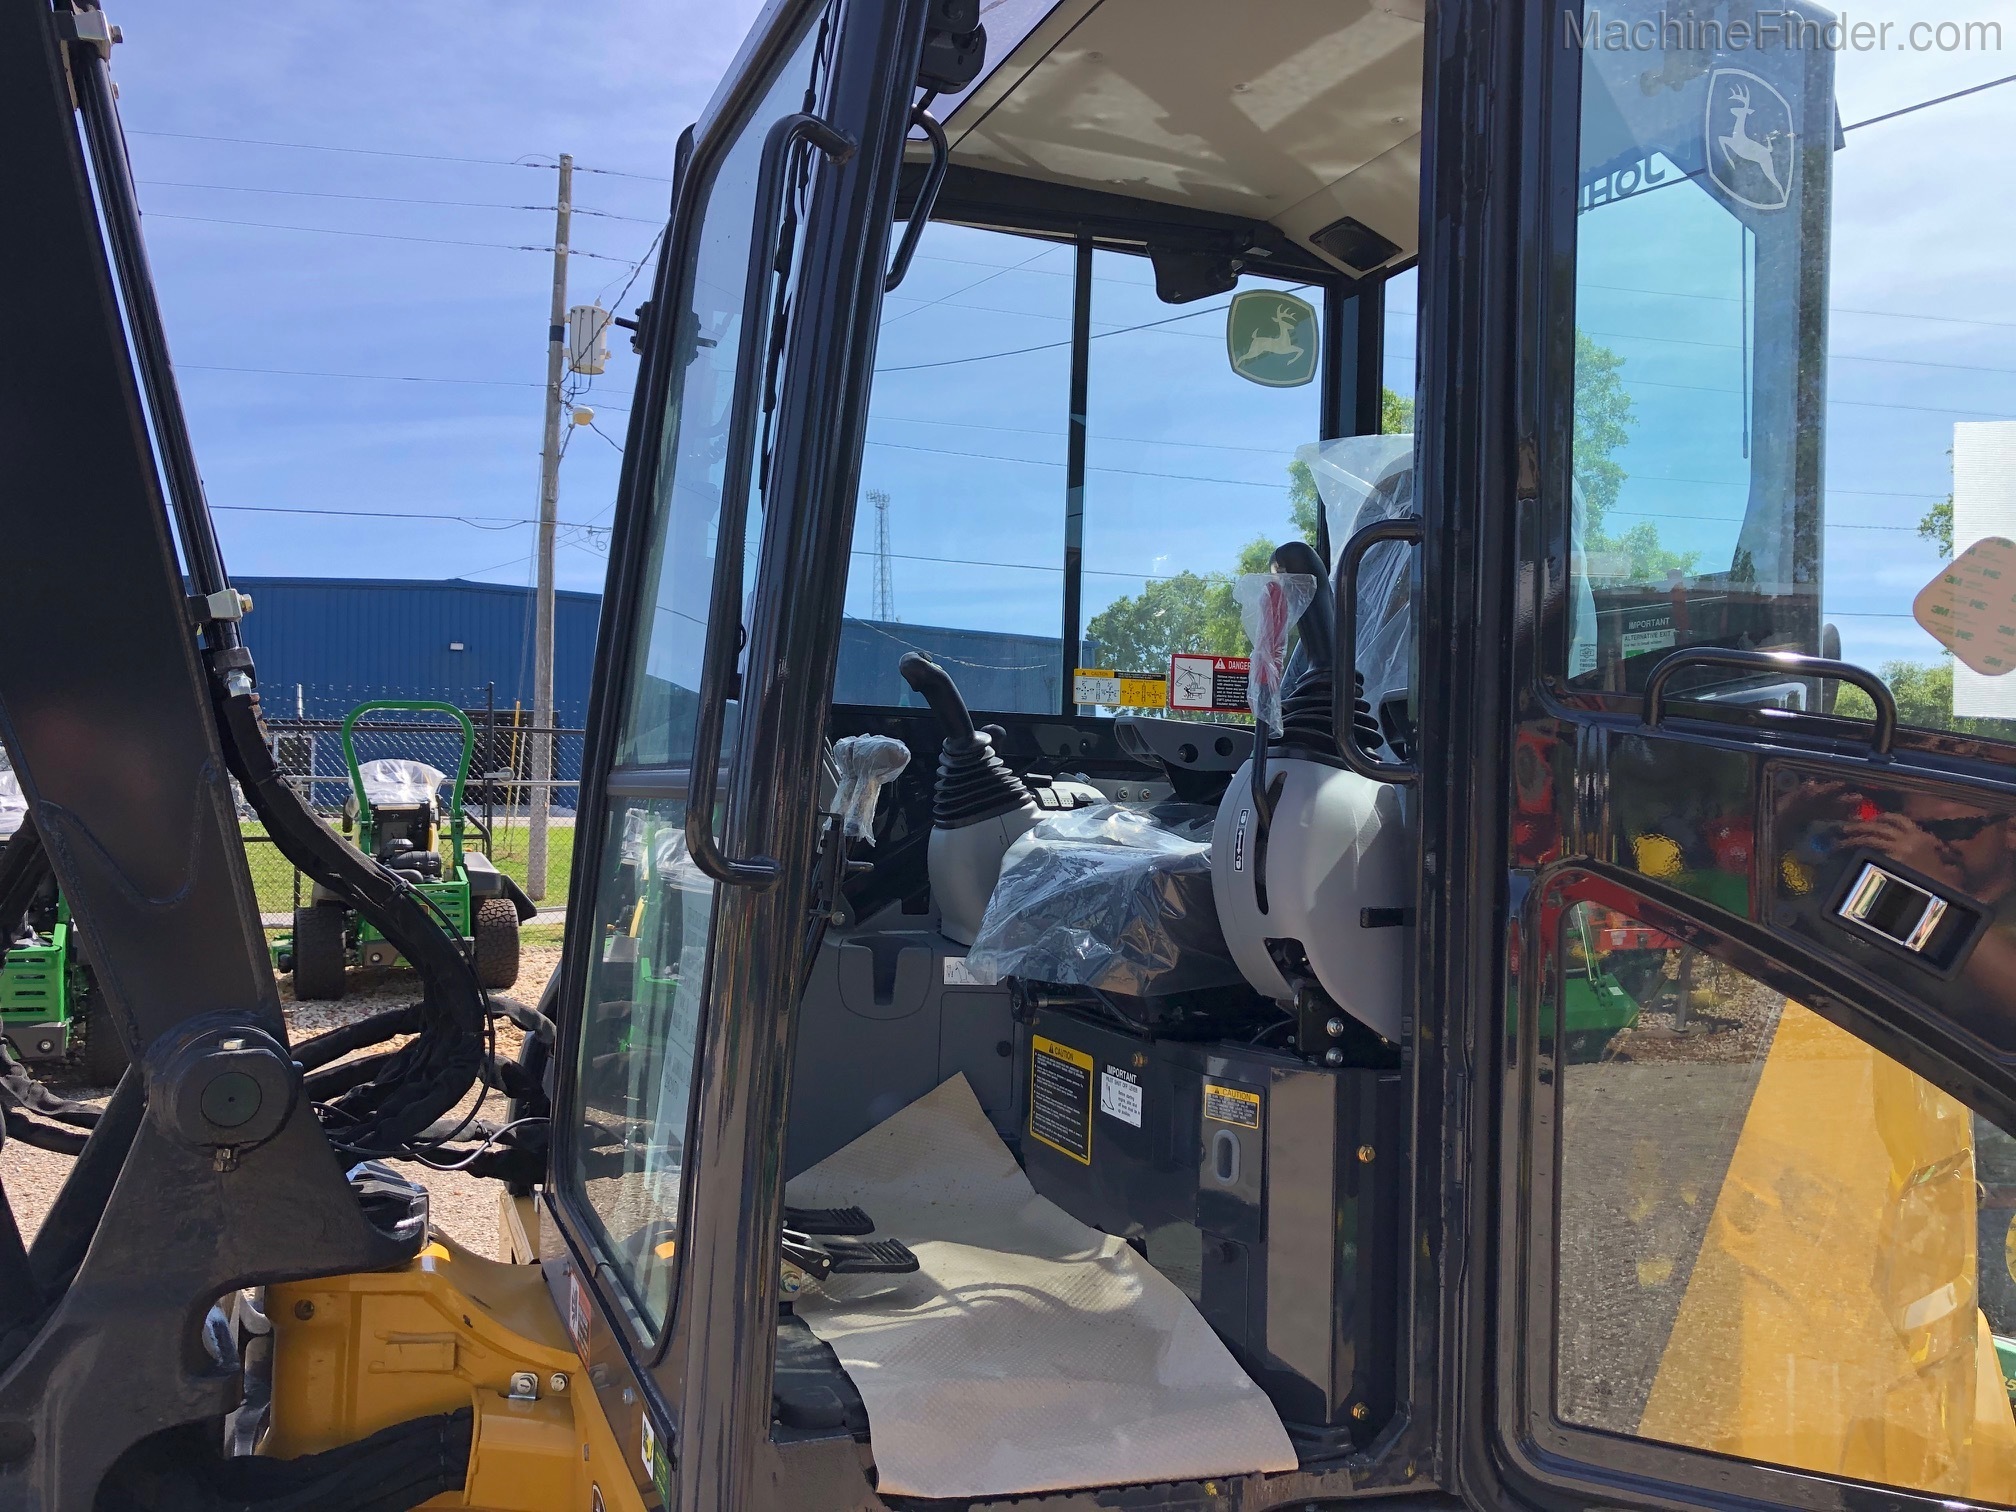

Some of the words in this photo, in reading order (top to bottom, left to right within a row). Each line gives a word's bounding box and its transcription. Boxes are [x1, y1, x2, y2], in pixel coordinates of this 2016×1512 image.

[1930, 604, 1950, 617] 3M
[1628, 617, 1670, 630] IMPORTANT
[1624, 632, 1658, 641] ALTERNATIVE
[1660, 630, 1673, 638] EXIT
[1054, 1046, 1074, 1061] CAUTION
[1107, 1064, 1137, 1083] IMPORTANT
[1222, 1089, 1250, 1100] CAUTION
